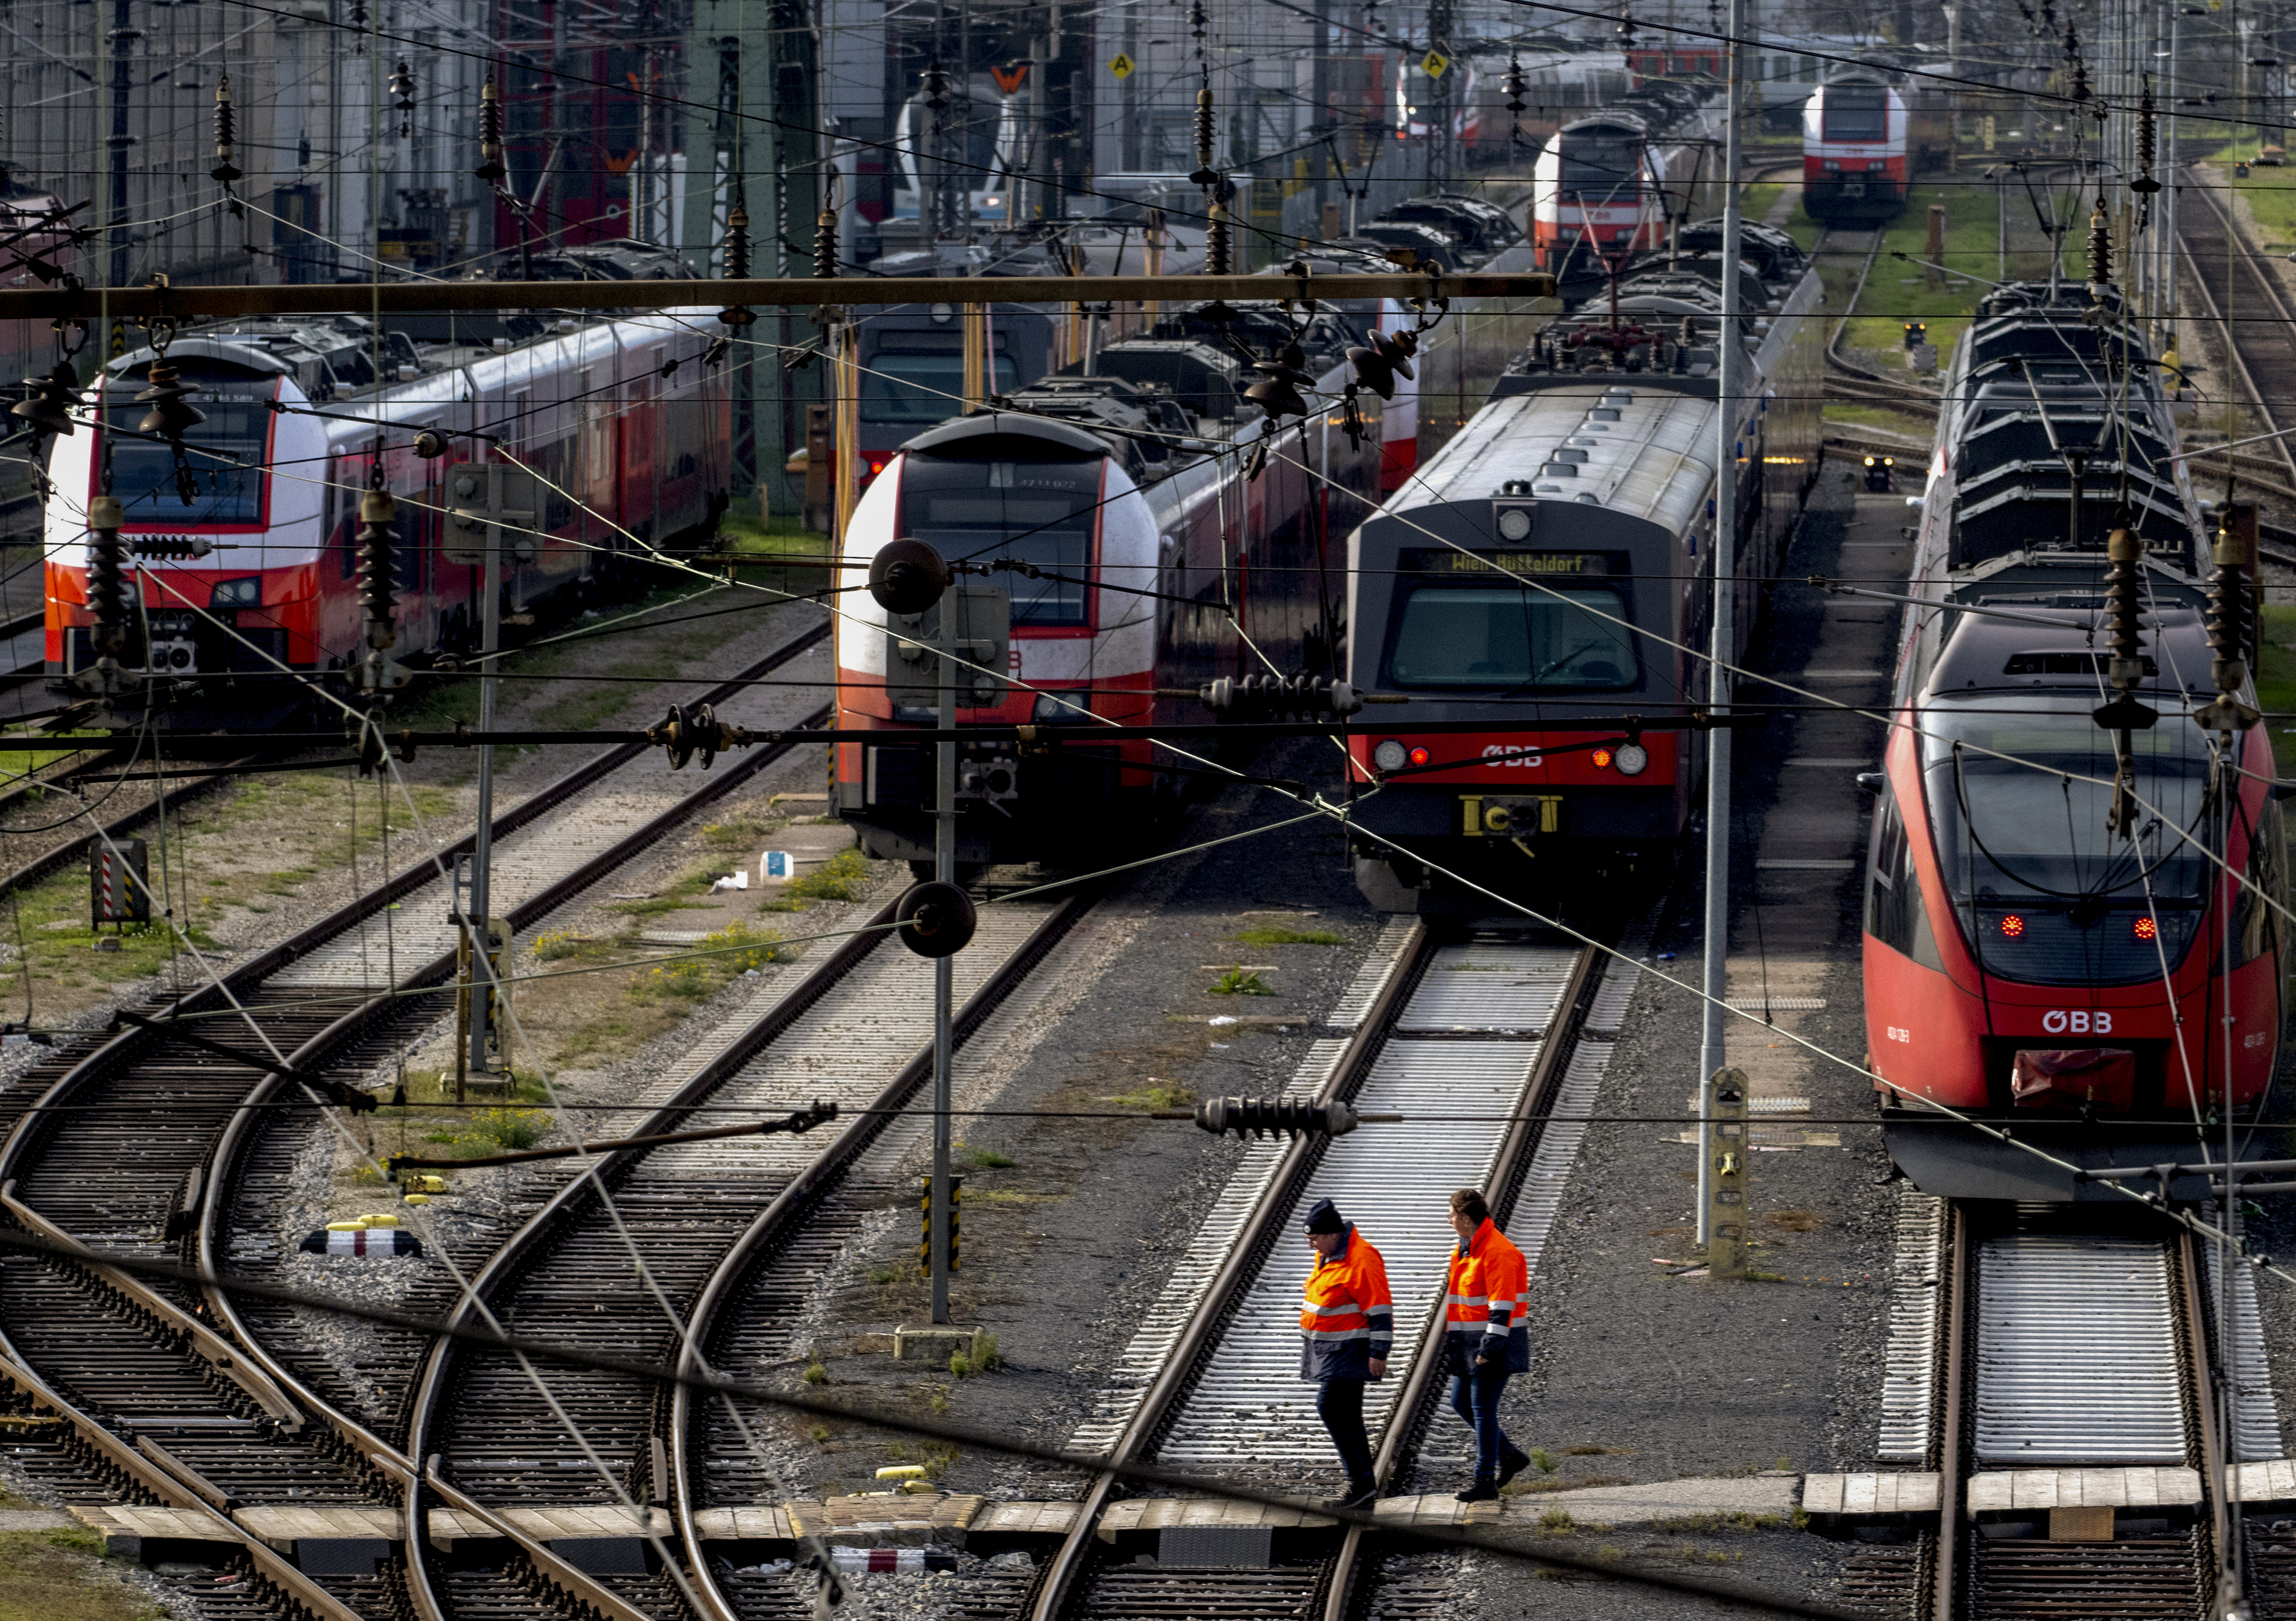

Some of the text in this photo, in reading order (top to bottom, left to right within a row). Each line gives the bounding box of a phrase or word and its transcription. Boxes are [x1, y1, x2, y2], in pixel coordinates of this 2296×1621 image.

[1115, 56, 1128, 71] A
[1429, 55, 1442, 70] A
[1452, 554, 1582, 572] Wien Hütteldorf
[1482, 745, 1542, 767] ÖBB
[2042, 1010, 2112, 1034] ÖBB
